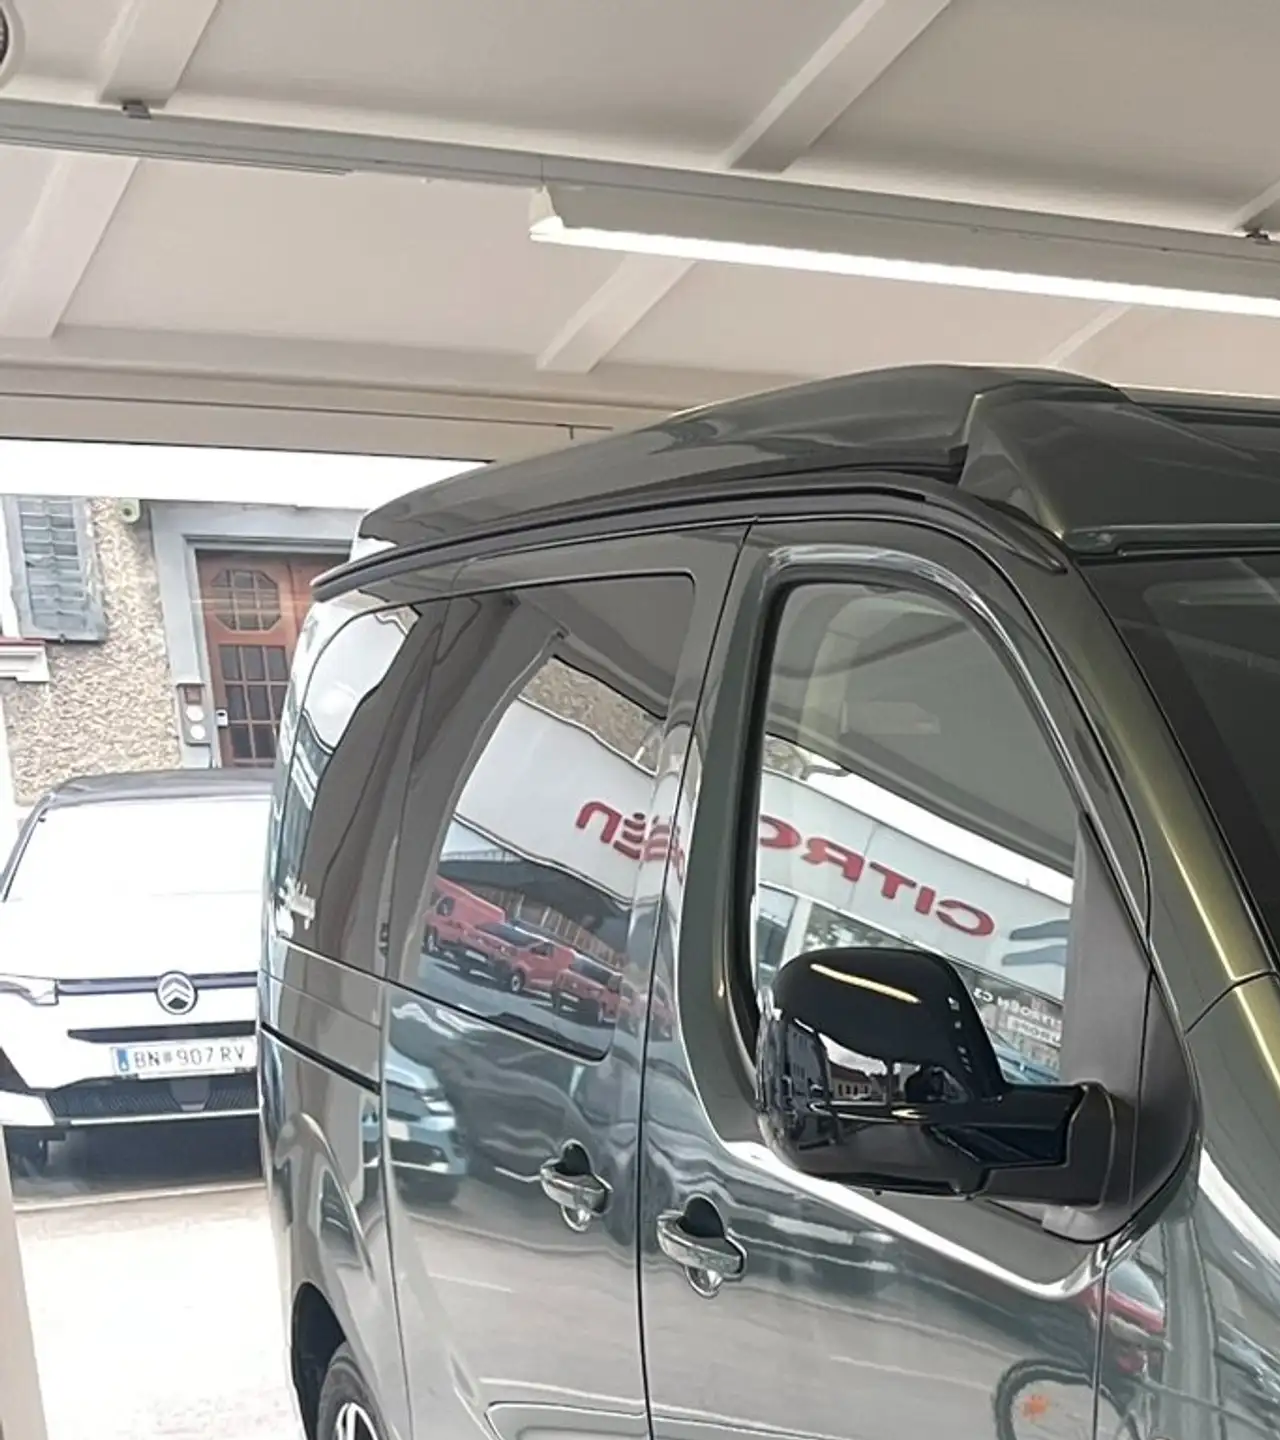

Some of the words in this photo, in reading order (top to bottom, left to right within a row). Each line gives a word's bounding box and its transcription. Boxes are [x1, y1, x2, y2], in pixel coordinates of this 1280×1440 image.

[133, 1051, 160, 1069] BN
[175, 1047, 213, 1066] 907
[220, 1045, 245, 1061] RV
